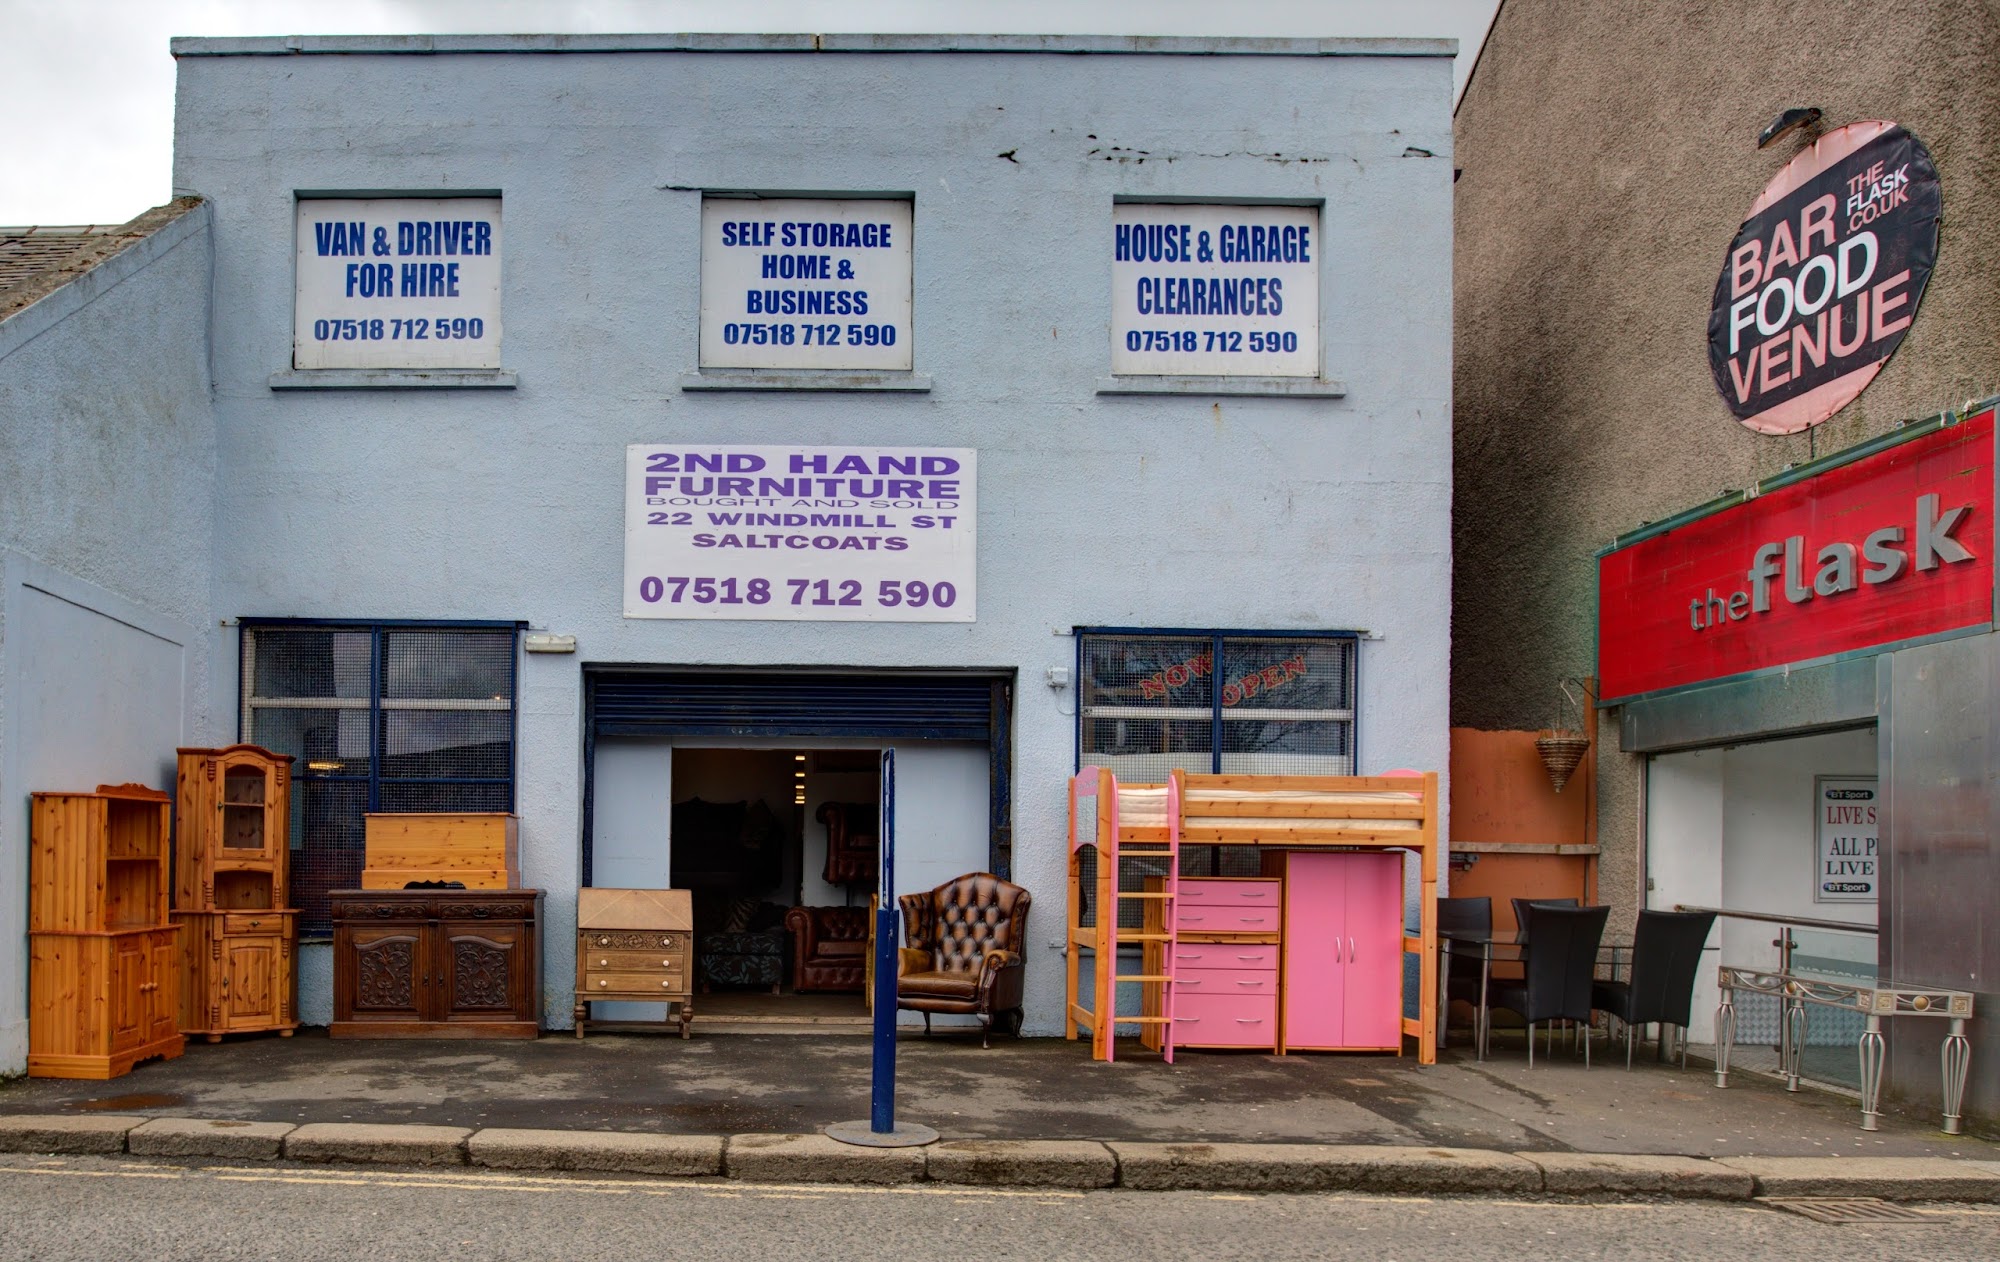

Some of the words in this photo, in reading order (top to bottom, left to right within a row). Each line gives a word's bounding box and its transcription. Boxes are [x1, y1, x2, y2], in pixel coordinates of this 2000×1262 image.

[1846, 160, 1885, 196] THE
[1847, 163, 1910, 217] FLASK
[315, 222, 365, 256] VAN
[372, 226, 391, 256] &
[398, 221, 491, 256] DRIVER
[722, 222, 775, 246] SELF
[781, 222, 891, 247] STORAGE
[1115, 224, 1191, 262] HOUSE
[1197, 230, 1214, 263] &
[1220, 225, 1310, 263] GARAGE
[1731, 193, 1837, 300] BAR
[762, 255, 831, 279] HOME
[837, 259, 855, 279] &
[346, 263, 393, 298] FOR
[401, 262, 459, 297] HIRE
[747, 290, 868, 315] BUSINESS
[1137, 277, 1282, 316] CLEARANCES
[1730, 231, 1879, 355] FOOD
[314, 319, 384, 340] 07518
[390, 318, 429, 339] 712
[435, 318, 483, 339] 590
[724, 323, 795, 345] 07518
[801, 324, 840, 346] 712
[847, 324, 896, 346] 590
[1728, 269, 1911, 405] VENUE
[1126, 330, 1197, 352] 07518
[1203, 331, 1242, 352] 712
[1249, 331, 1298, 353] 590
[645, 453, 766, 473] 2ND
[789, 454, 960, 476] HAND
[645, 476, 960, 500] FURNITURE
[646, 497, 781, 507] BOUGHT
[791, 498, 859, 508] AND
[869, 499, 958, 510] SOLD
[647, 512, 693, 525] 22
[707, 513, 896, 528] WINDMILL
[911, 515, 957, 529] ST
[692, 533, 909, 551] SALTCOATS
[639, 576, 771, 604] 07518
[787, 578, 862, 606] 712
[877, 580, 957, 608] 590
[1139, 652, 1213, 700] NOW
[1220, 655, 1308, 706] OPEN
[1845, 790, 1869, 799] Sport
[1826, 806, 1862, 824] LIVE
[1830, 837, 1860, 856] ALL
[1825, 861, 1874, 875] LIVE
[1842, 884, 1866, 892] Sport
